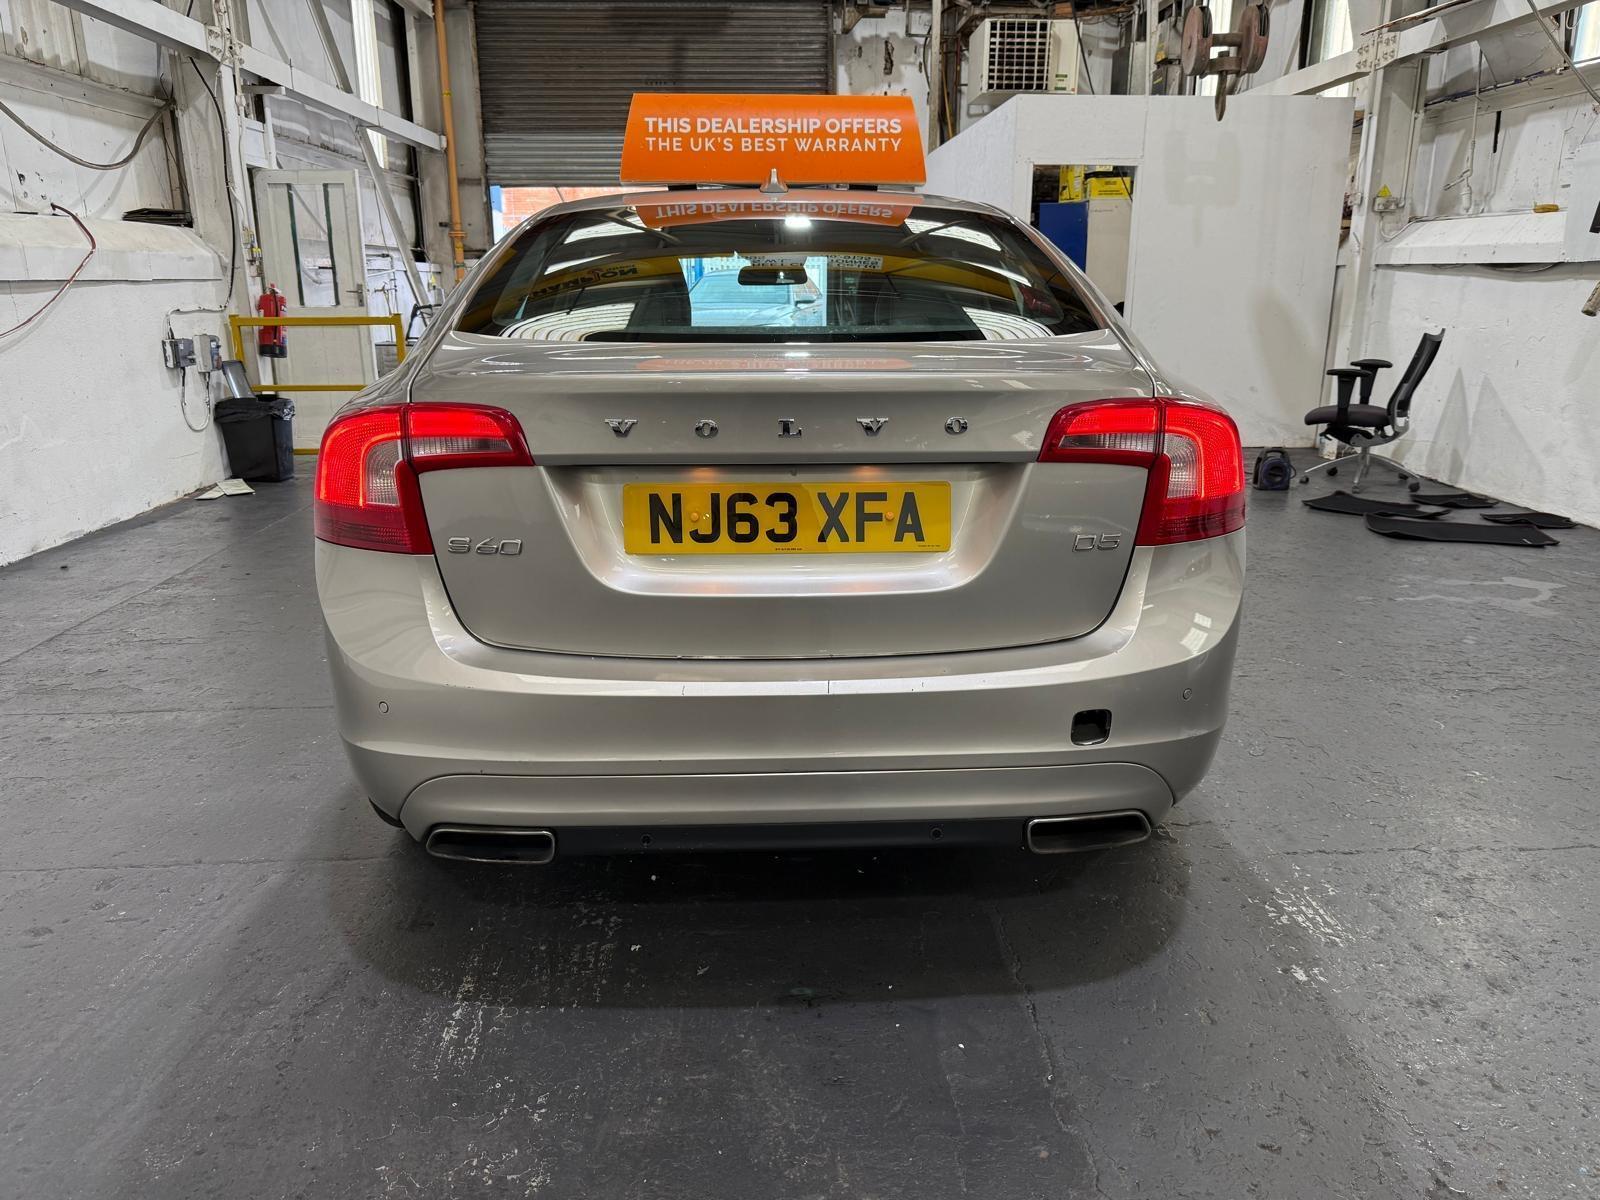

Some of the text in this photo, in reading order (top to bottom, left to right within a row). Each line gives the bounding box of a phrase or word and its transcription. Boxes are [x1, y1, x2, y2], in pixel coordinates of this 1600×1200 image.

[645, 117, 902, 134] THIS DEALERSHIP OFFERS
[646, 137, 902, 152] THE UK'S BEST WARRANTY
[604, 417, 969, 438] VOLVO
[648, 492, 925, 544] NJ63 XFA
[448, 536, 523, 555] S60
[1073, 533, 1121, 551] D5
